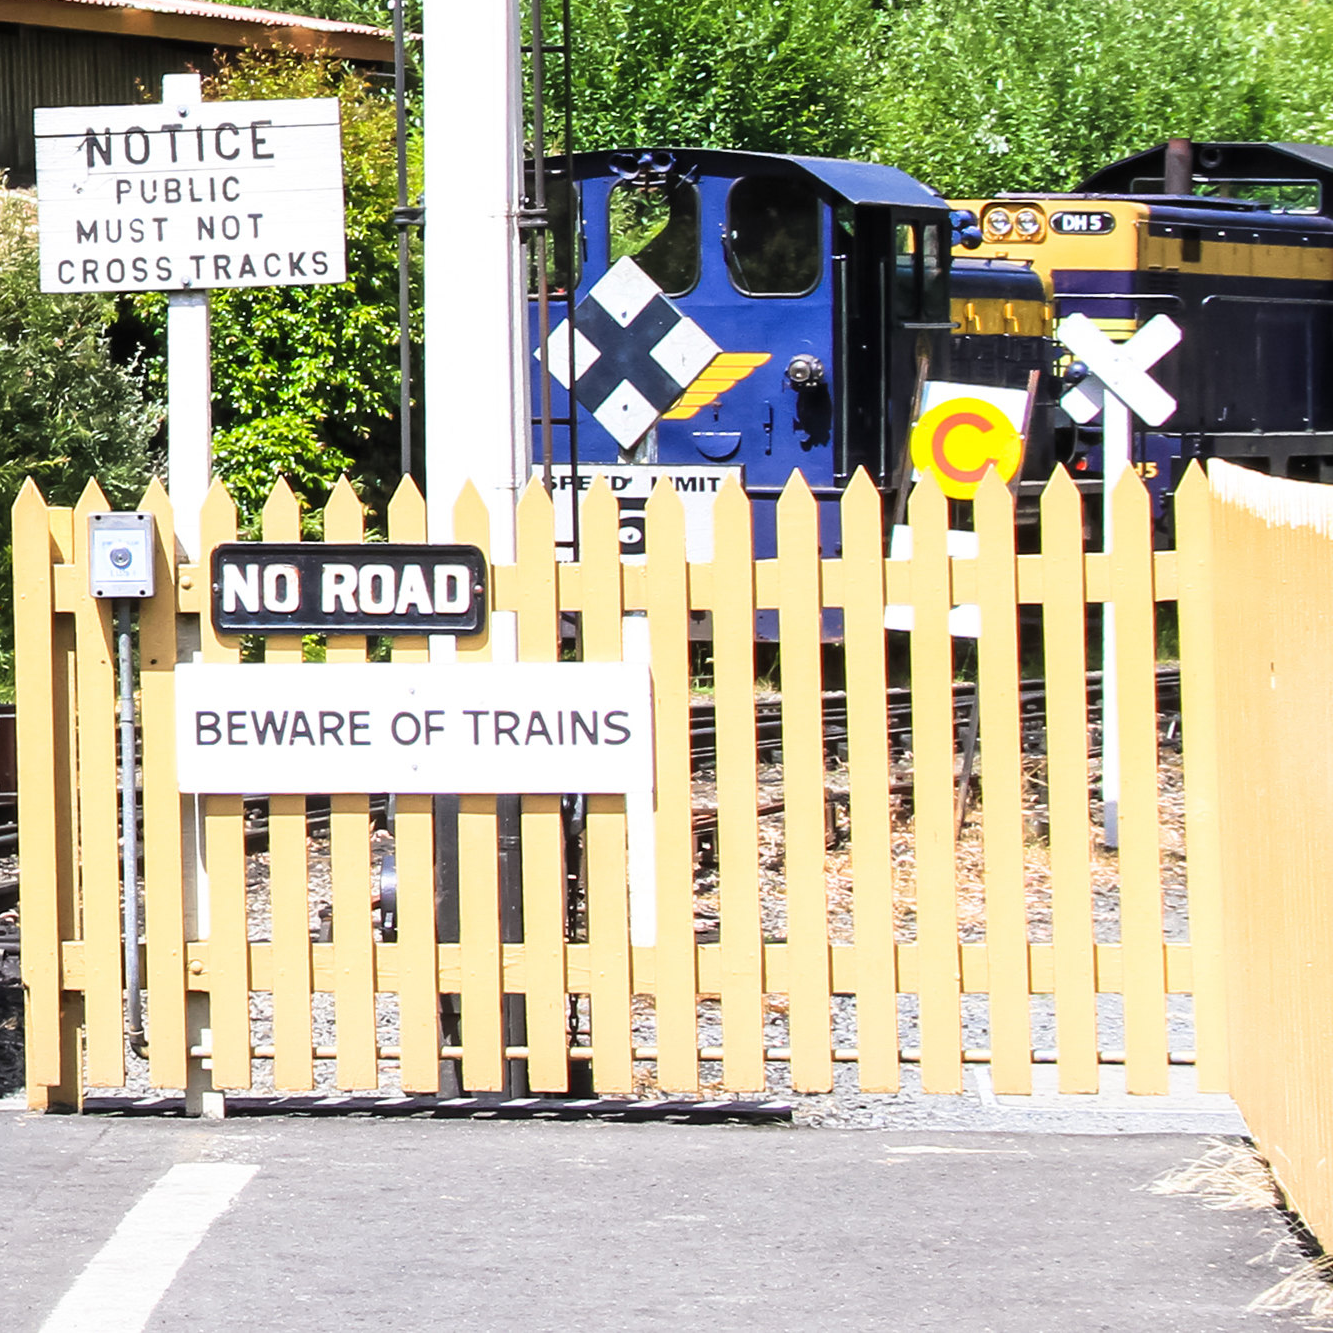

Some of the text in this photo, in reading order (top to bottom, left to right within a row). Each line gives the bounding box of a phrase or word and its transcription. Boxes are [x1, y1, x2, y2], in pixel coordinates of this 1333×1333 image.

[86, 120, 274, 166] NOTICE
[116, 176, 241, 204] PUBLIC
[76, 214, 263, 244] MUST NOT
[57, 251, 329, 284] CROSS TRACKS
[931, 412, 1000, 483] C
[545, 475, 721, 492] SPED MIT
[222, 564, 471, 615] NO ROAD
[195, 710, 632, 746] BEWARE OF TRAINS
